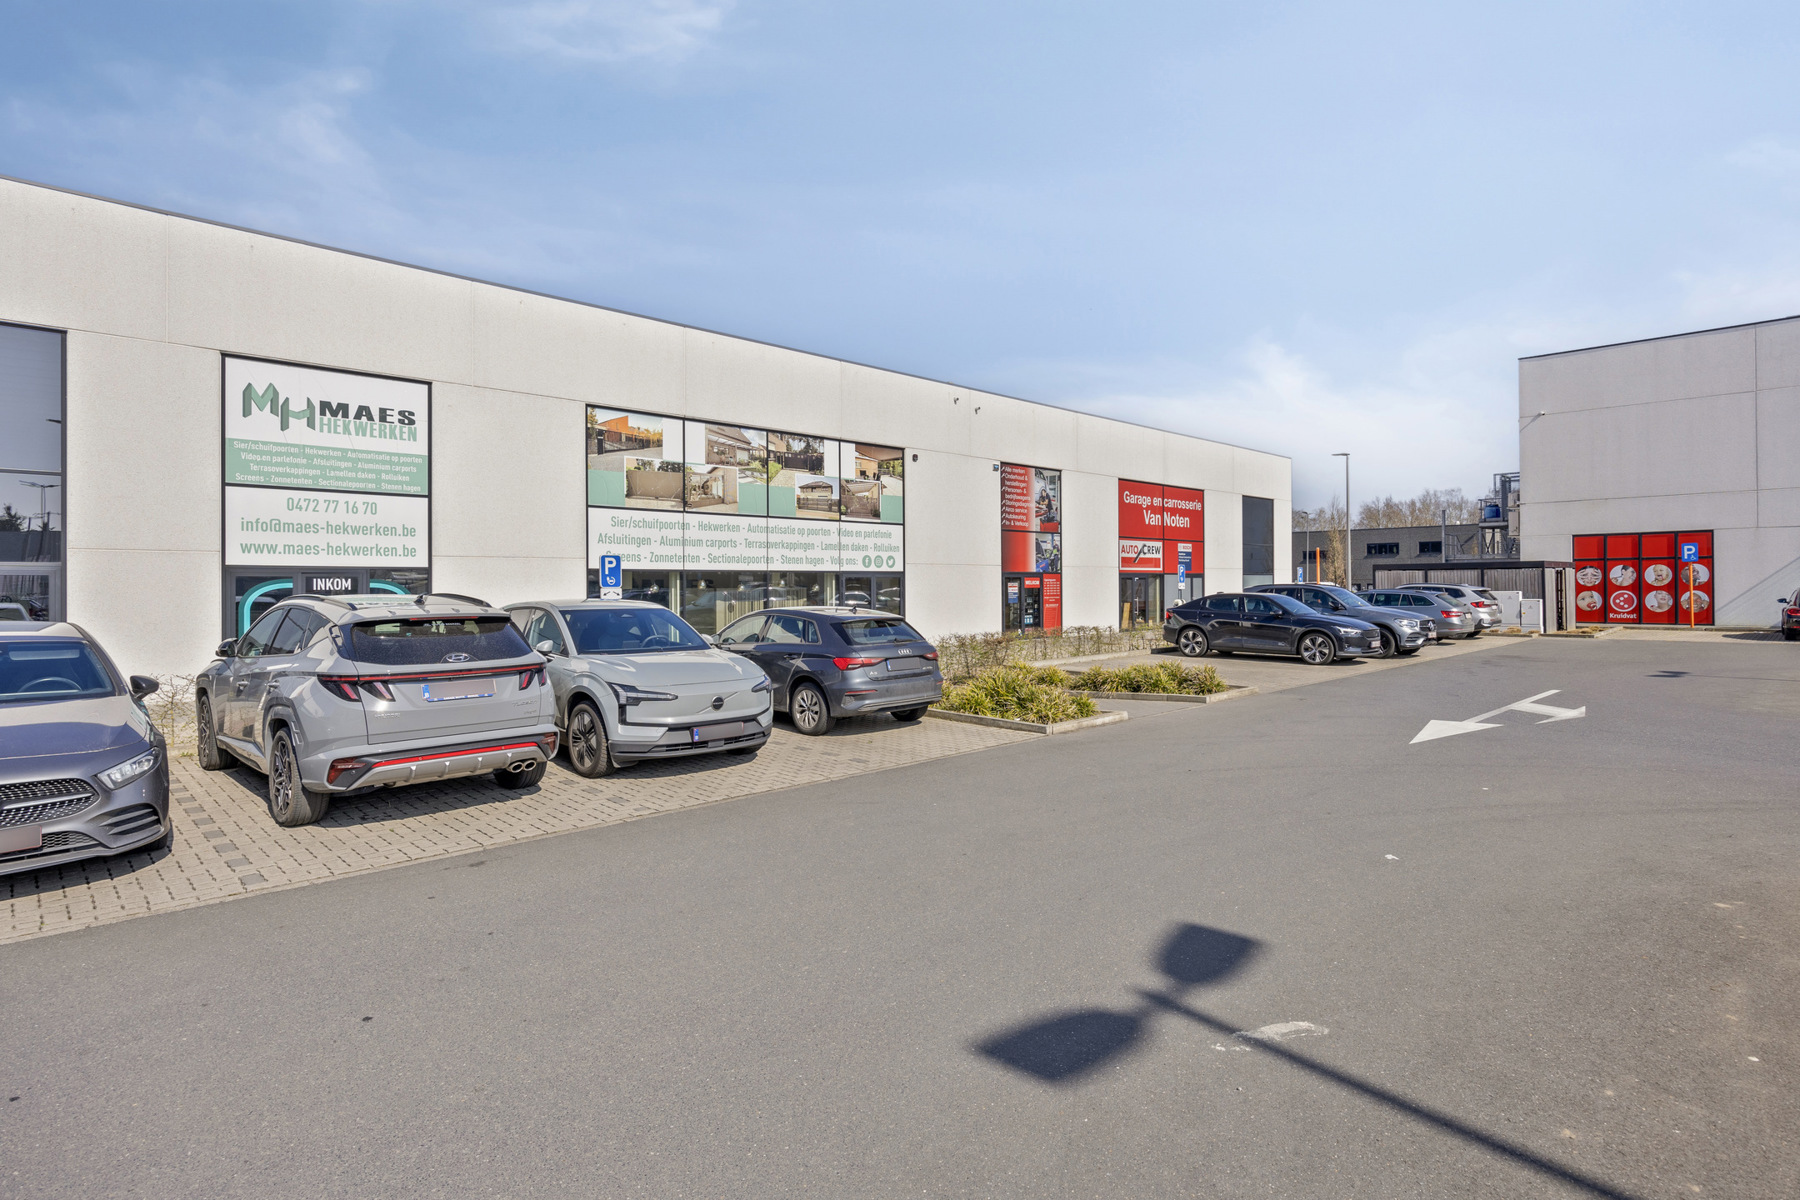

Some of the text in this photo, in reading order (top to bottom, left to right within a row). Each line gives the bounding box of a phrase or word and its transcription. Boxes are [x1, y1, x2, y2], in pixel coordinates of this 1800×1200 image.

[319, 400, 416, 426] MAES
[319, 416, 417, 442] HEKWERKEN
[233, 441, 299, 454] Sier/schuifpoorten
[305, 447, 341, 457] Hekwerken
[347, 451, 390, 461] Automatisatie
[250, 463, 320, 476] Terrasoverkappingen
[326, 469, 356, 478] Lamellen
[357, 471, 376, 479] daken
[381, 473, 410, 481] Rolluiken
[313, 458, 352, 468] Afsluitingen
[358, 462, 391, 471] Aluminium
[392, 465, 416, 473] carports
[235, 473, 264, 481] Screens
[271, 475, 312, 485] Zonnetenten
[381, 482, 402, 490] Stenen
[403, 484, 421, 493] hagen
[286, 497, 378, 515] 0472 77 16 70
[1123, 491, 1202, 511] Garage en carrosserie
[240, 517, 417, 538] info@maes-hekwerken.be
[611, 516, 690, 532] Sier/schuifpoorten
[698, 521, 740, 533] Hekwerken
[747, 523, 796, 535] Automatisatie
[797, 527, 806, 537] op
[807, 527, 831, 538] poorten
[836, 527, 854, 537] Video
[855, 530, 862, 538] en
[863, 529, 892, 540] parlefonie
[1143, 509, 1190, 528] Van Noten
[240, 541, 417, 558] www.maes-hekwerken.be
[597, 532, 652, 548] Afsluitingen
[660, 535, 704, 548] Aluminium
[705, 538, 738, 550] carports
[744, 538, 815, 552] Terrasoverkappingen
[820, 541, 850, 552] Lamellen
[850, 542, 869, 552] daken
[873, 542, 900, 553] Rolluiken
[1683, 545, 1696, 559] P
[605, 557, 617, 575] P
[606, 551, 641, 563] eens
[650, 551, 700, 563] Zonnetenten
[707, 552, 774, 566] Sectionalepoorten
[781, 554, 804, 565] Stenen
[805, 555, 824, 567] hagen
[830, 556, 845, 567] Volg
[846, 558, 859, 566] ons:
[312, 577, 352, 591] INKOM
